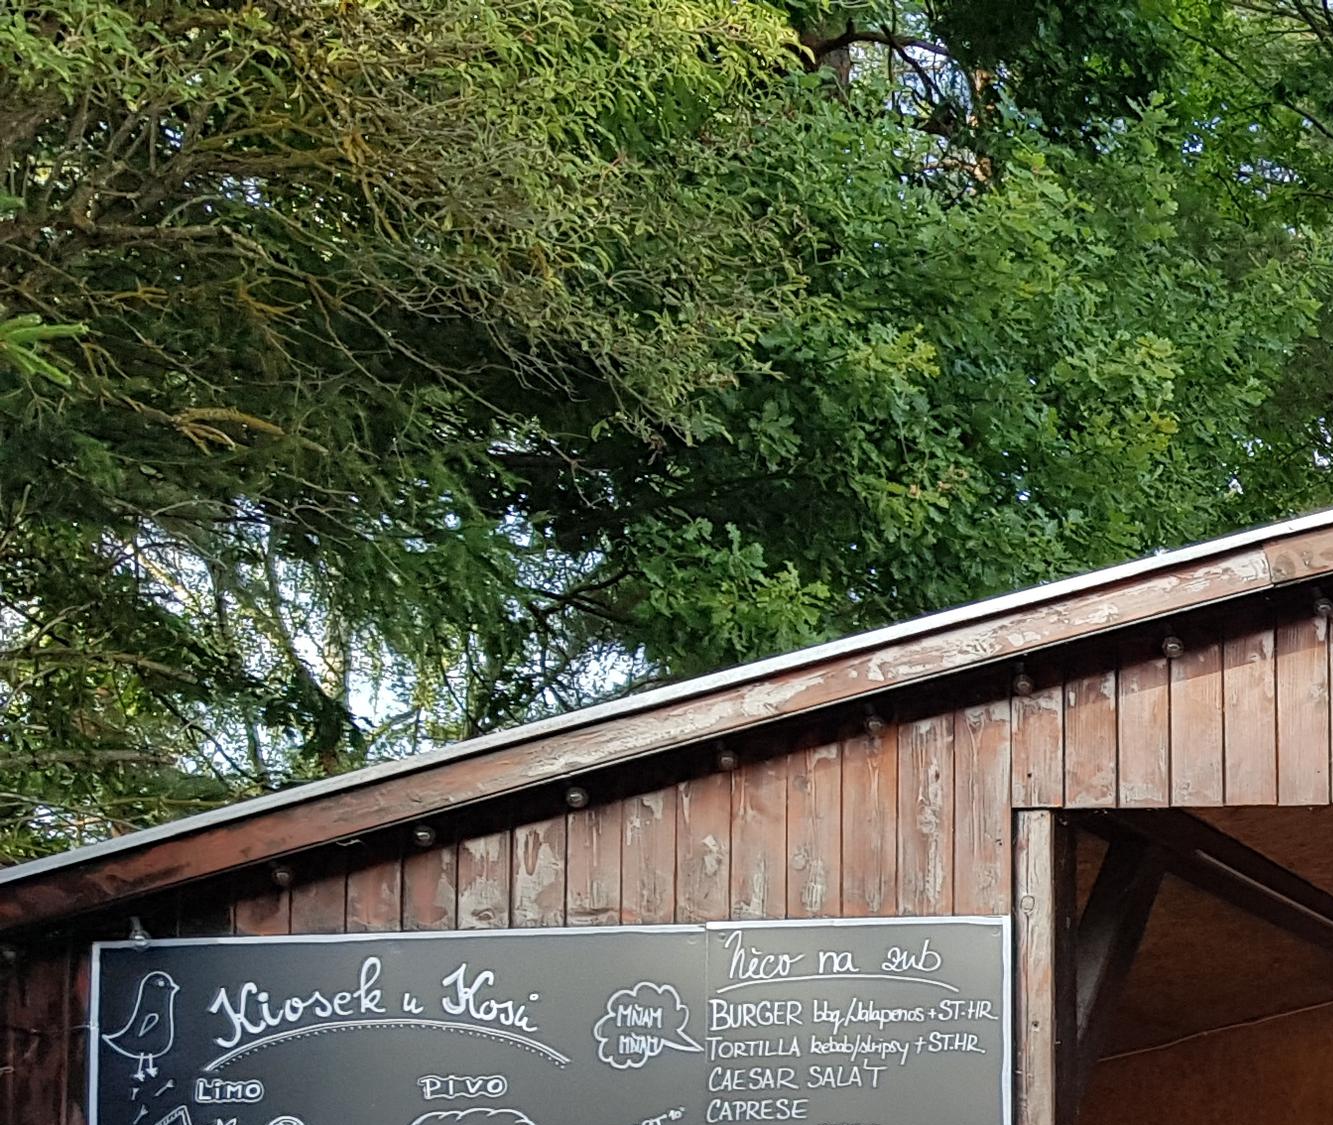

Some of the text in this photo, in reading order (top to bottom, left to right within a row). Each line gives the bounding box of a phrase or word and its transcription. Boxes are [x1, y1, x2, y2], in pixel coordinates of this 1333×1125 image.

[818, 951, 860, 974] na
[881, 940, 942, 972] zub
[209, 957, 387, 1048] Kiosek
[403, 992, 424, 1014] u
[708, 999, 804, 1032] BURGER
[706, 1036, 801, 1061] TORTILLA
[421, 1077, 505, 1098] PIVO
[708, 1059, 888, 1092] CAESAR SALÁT
[706, 1098, 809, 1124] CAPRESE
